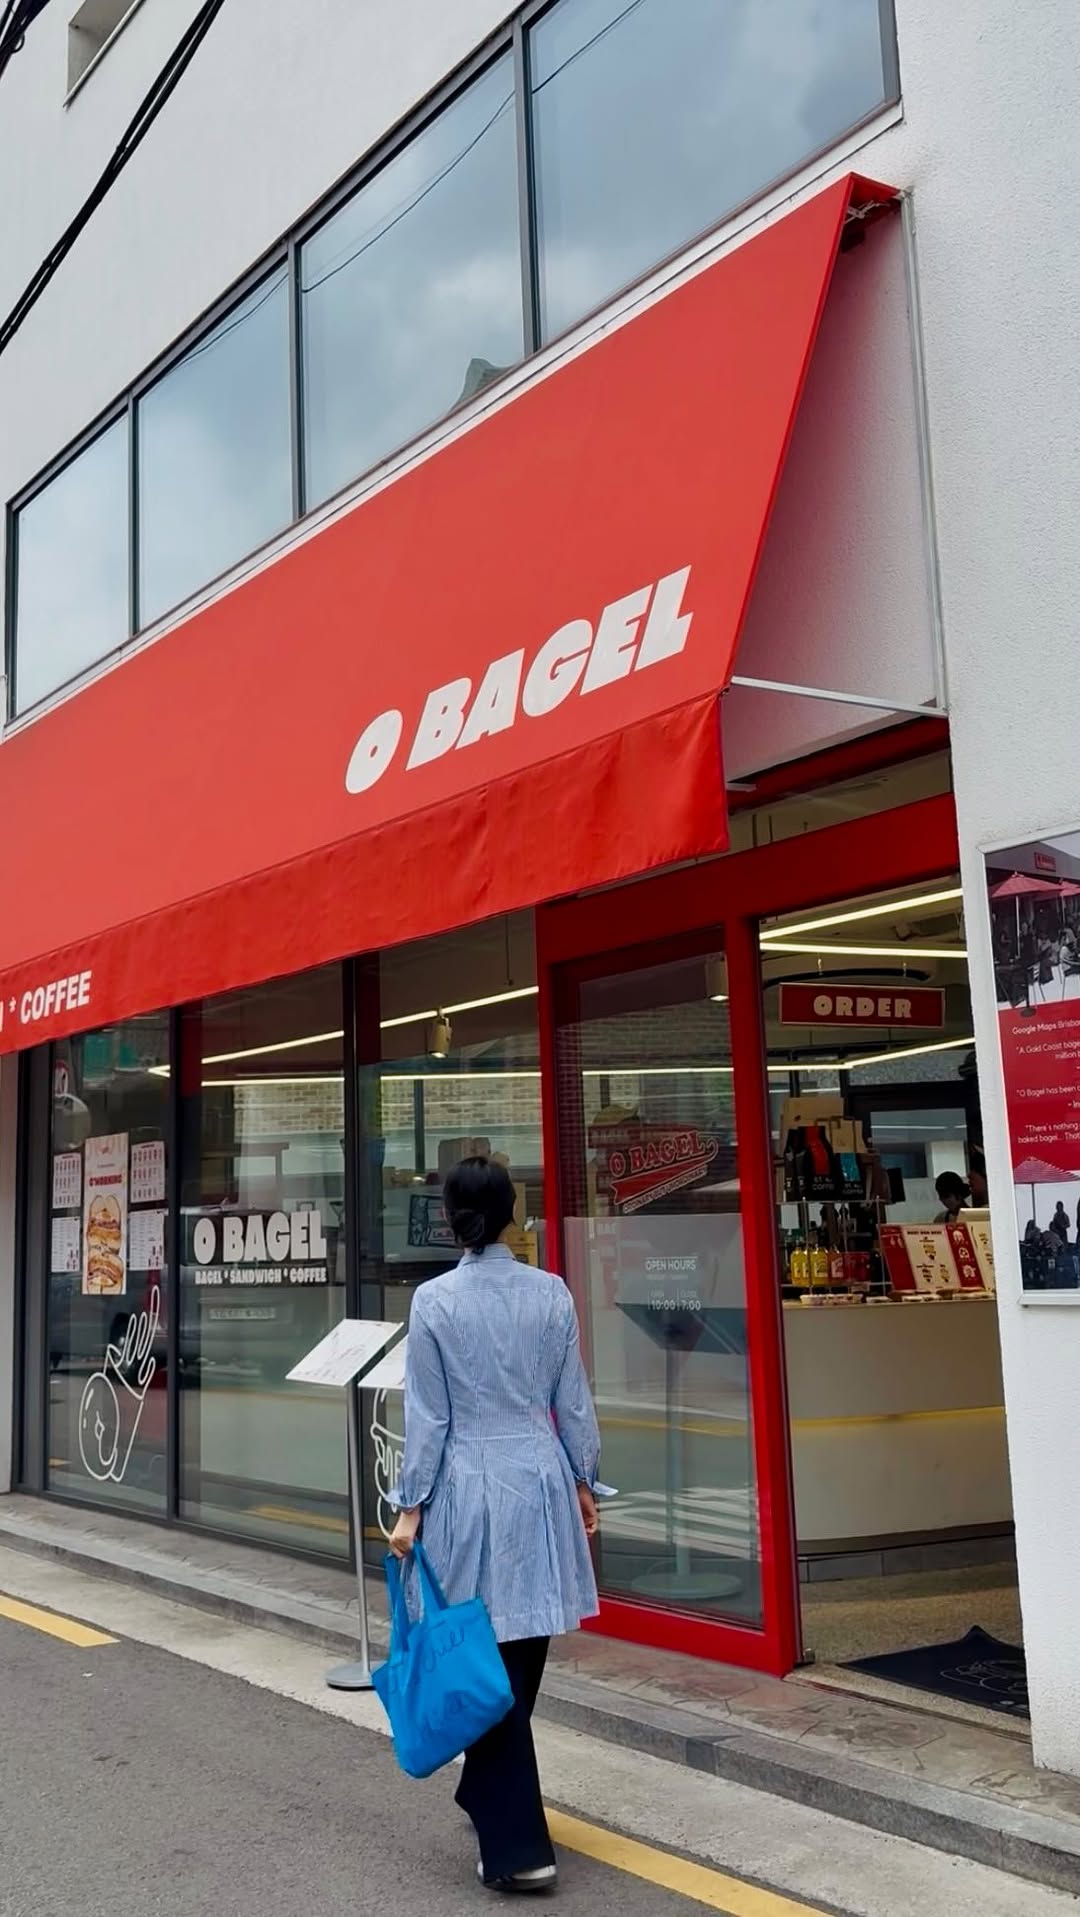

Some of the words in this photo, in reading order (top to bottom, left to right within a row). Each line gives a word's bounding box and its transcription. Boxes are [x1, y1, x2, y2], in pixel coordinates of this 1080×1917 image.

[345, 709, 404, 795] O
[405, 564, 694, 771] BAGEL
[20, 970, 92, 1025] COFFEE
[813, 994, 912, 1019] ORDER
[1012, 1025, 1036, 1035] Google
[1037, 1023, 1056, 1031] Maps
[1026, 1044, 1042, 1054] Gold
[1043, 1042, 1062, 1051] Coast
[1026, 1088, 1045, 1098] Bagel
[1046, 1087, 1058, 1095] has
[1059, 1085, 1077, 1094] been
[1053, 1122, 1078, 1131] nothing
[1018, 1135, 1038, 1144] baked
[610, 1152, 626, 1178] O
[630, 1130, 705, 1173] BAGEL
[193, 1217, 216, 1265] O
[222, 1210, 327, 1263] BAGEL
[645, 1260, 666, 1271] OPEN
[667, 1259, 697, 1271] HOURS
[195, 1271, 223, 1285] BAGEL
[230, 1268, 282, 1284] SANDWICH
[289, 1267, 327, 1283] COFFEE
[651, 1300, 676, 1311] 10:00
[682, 1300, 701, 1311] 7:00
